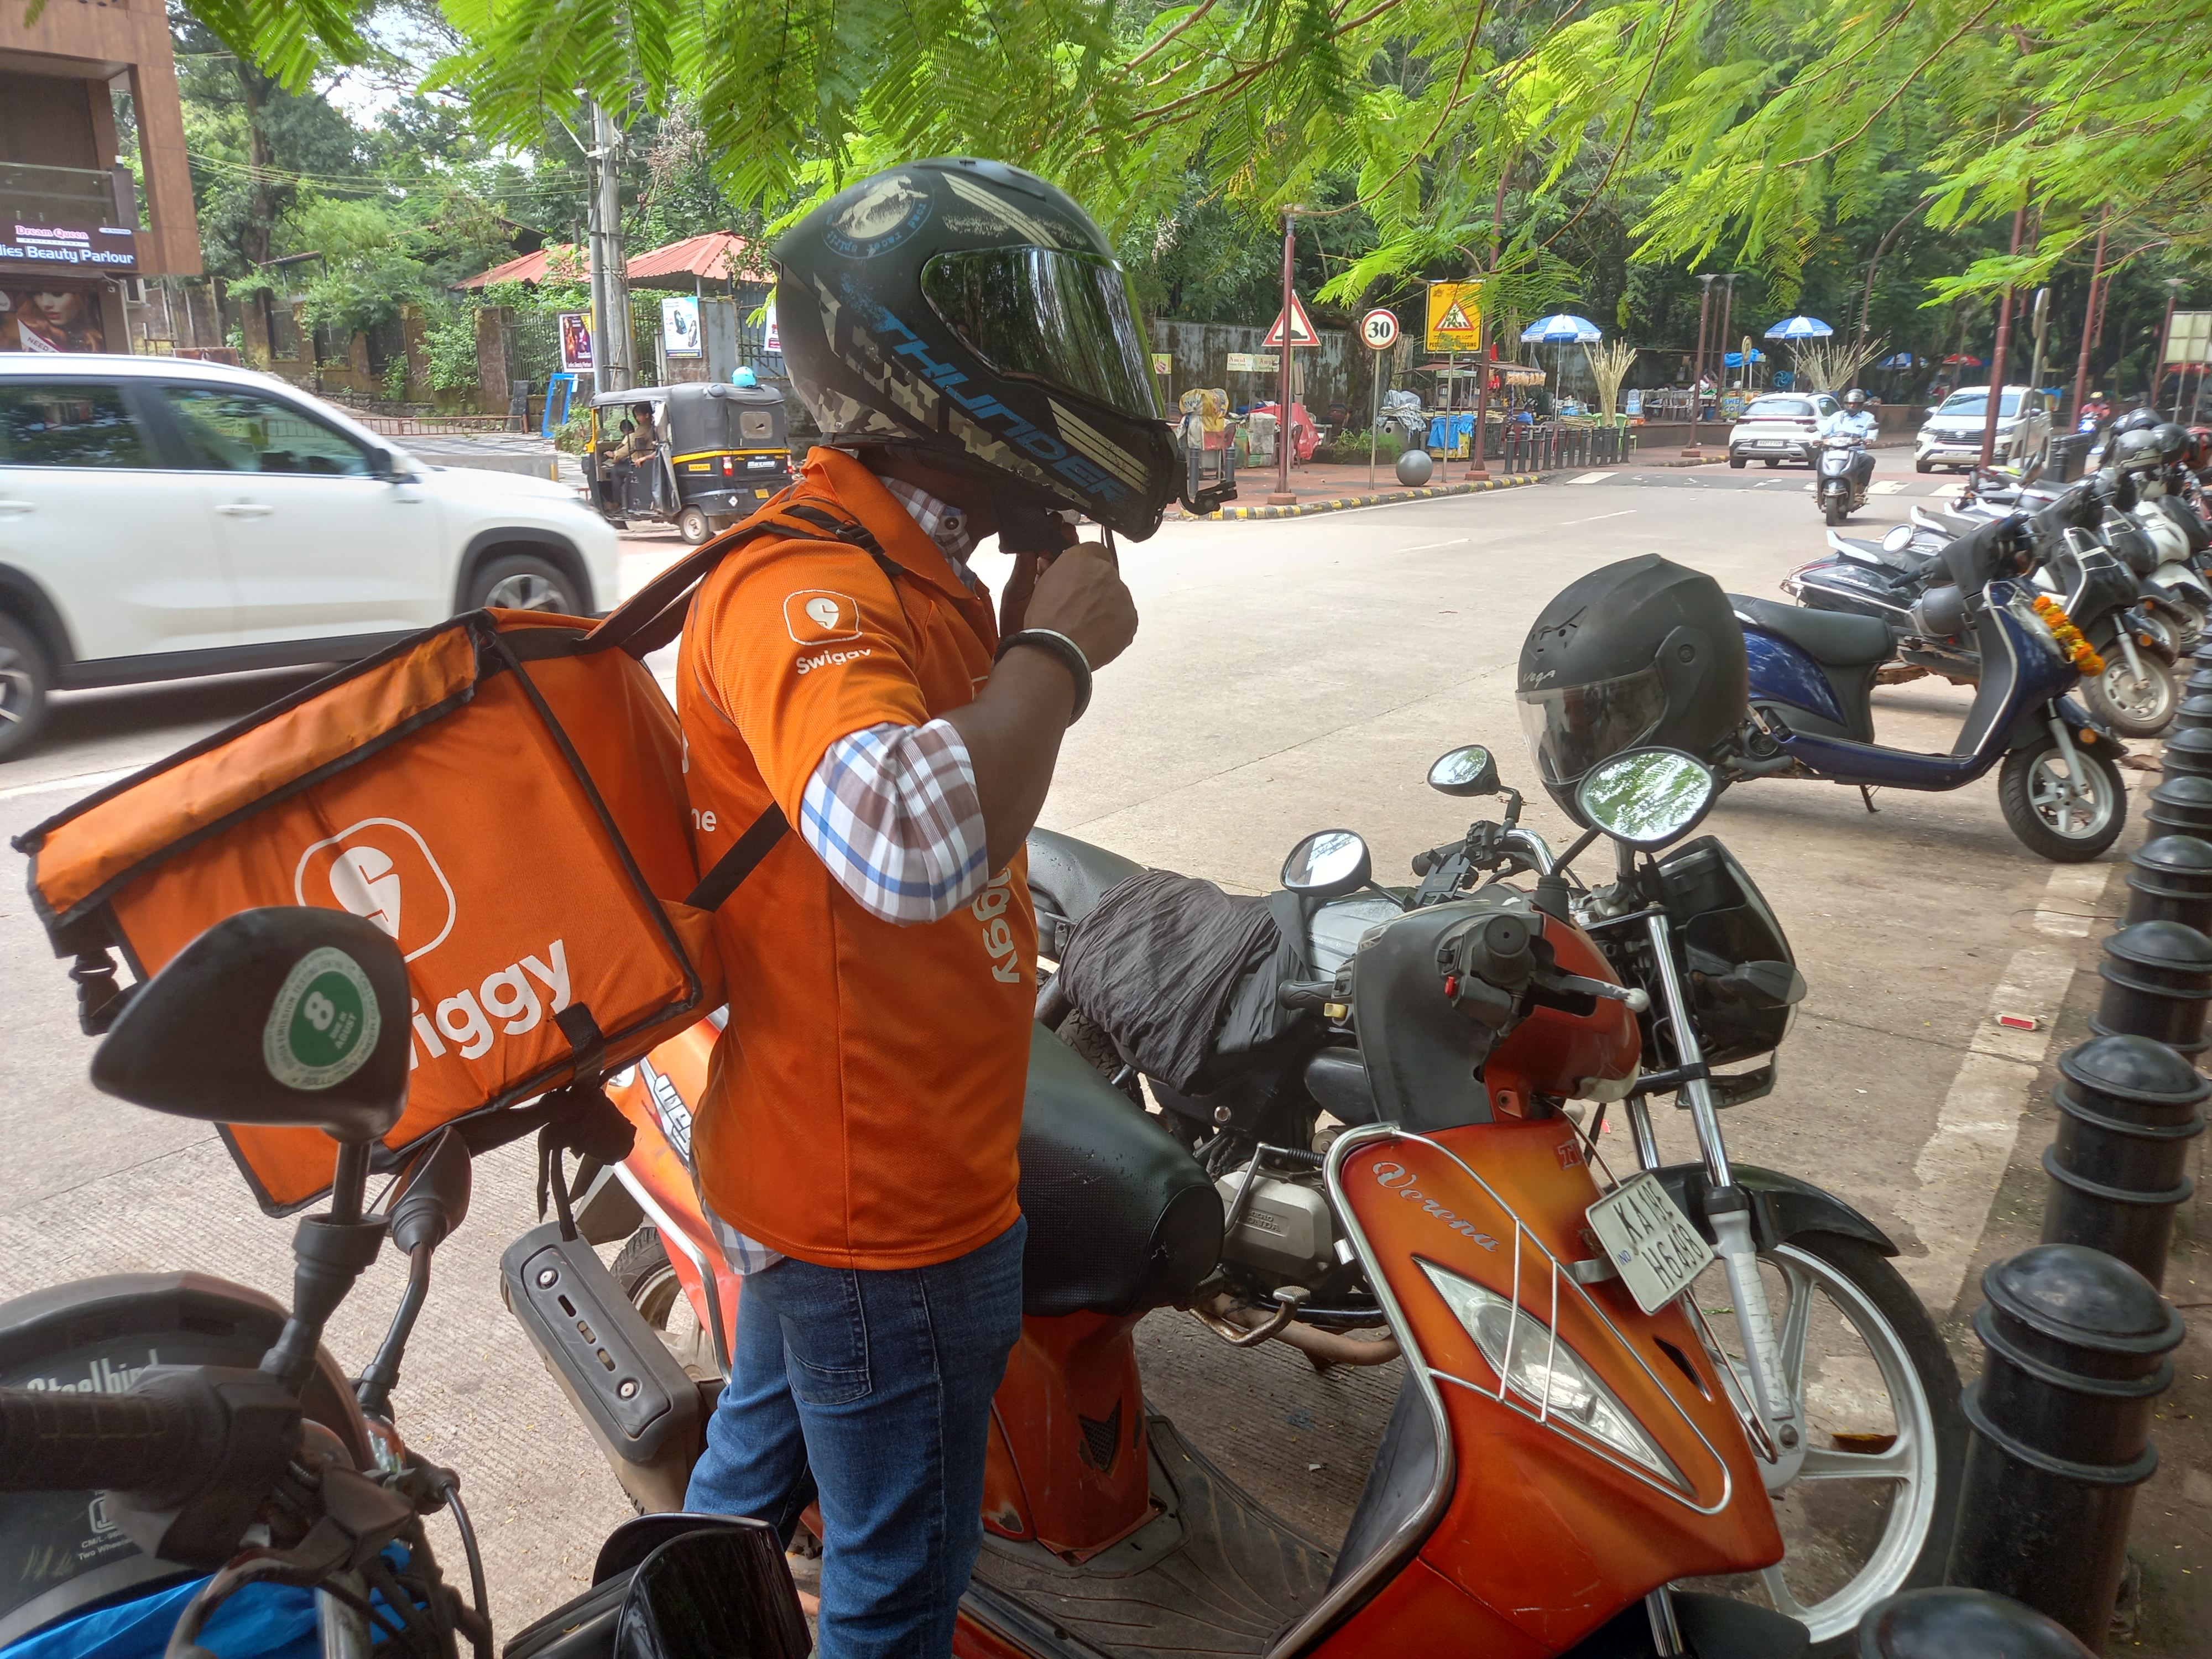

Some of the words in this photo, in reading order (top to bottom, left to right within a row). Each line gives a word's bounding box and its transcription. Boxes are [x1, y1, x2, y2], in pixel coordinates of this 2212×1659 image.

[15, 226, 53, 237] Dream
[54, 228, 89, 239] Queen
[26, 246, 79, 264] Beauty
[80, 249, 134, 264] Parlour
[1368, 321, 1391, 338] 30
[27, 337, 49, 351] NEED
[871, 305, 1129, 501] THUNDER
[972, 867, 1020, 983] iggy
[304, 991, 335, 1031] 8
[410, 939, 571, 1071] iggy
[1371, 1161, 1503, 1254] Verena
[1248, 1216, 1281, 1233] ONDA
[78, 1550, 96, 1561] Two
